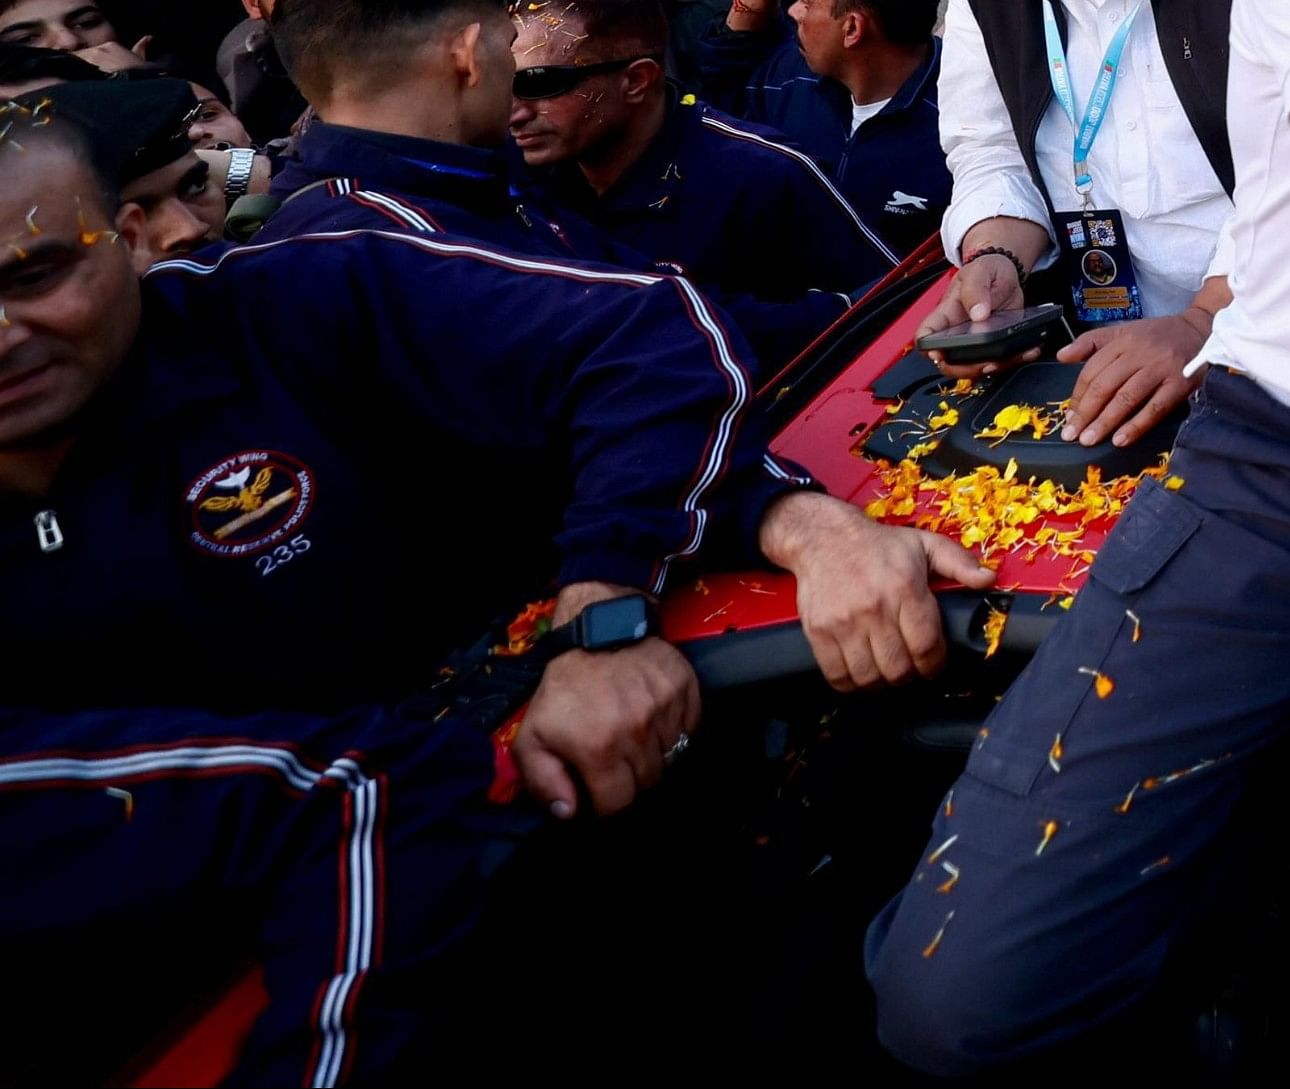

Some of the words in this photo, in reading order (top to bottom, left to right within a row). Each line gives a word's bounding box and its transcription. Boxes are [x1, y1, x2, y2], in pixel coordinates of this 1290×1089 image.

[186, 458, 236, 502] SECURITY
[238, 452, 268, 464] WING
[255, 533, 311, 577] 235
